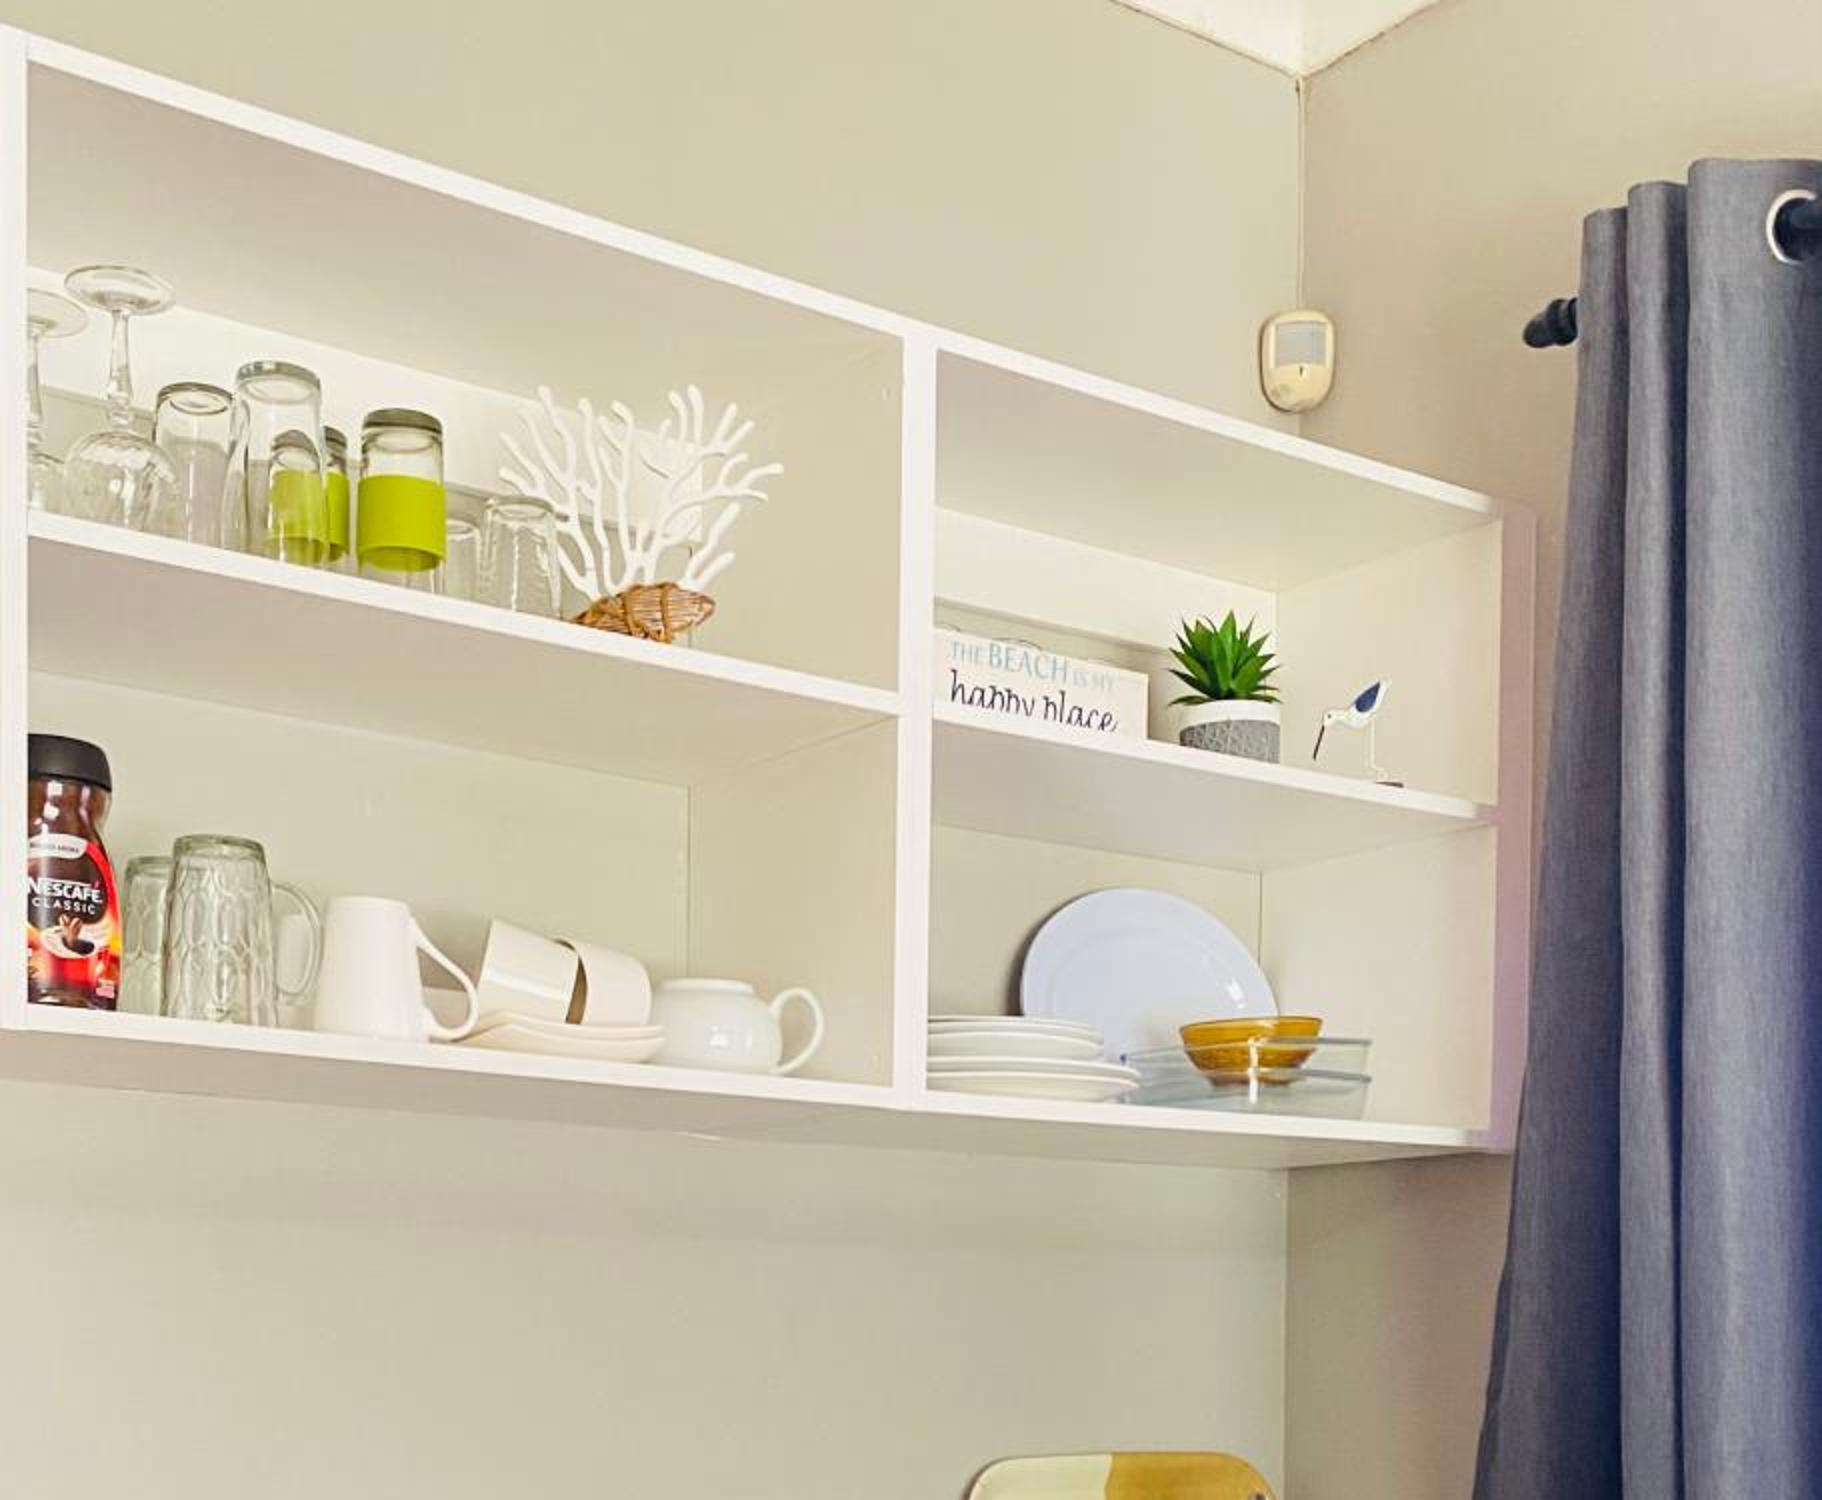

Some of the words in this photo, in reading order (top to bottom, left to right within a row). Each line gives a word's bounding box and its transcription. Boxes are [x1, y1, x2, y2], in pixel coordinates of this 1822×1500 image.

[951, 641, 983, 664] THE
[989, 643, 1068, 684] BEACH
[31, 897, 97, 915] CLASSIC
